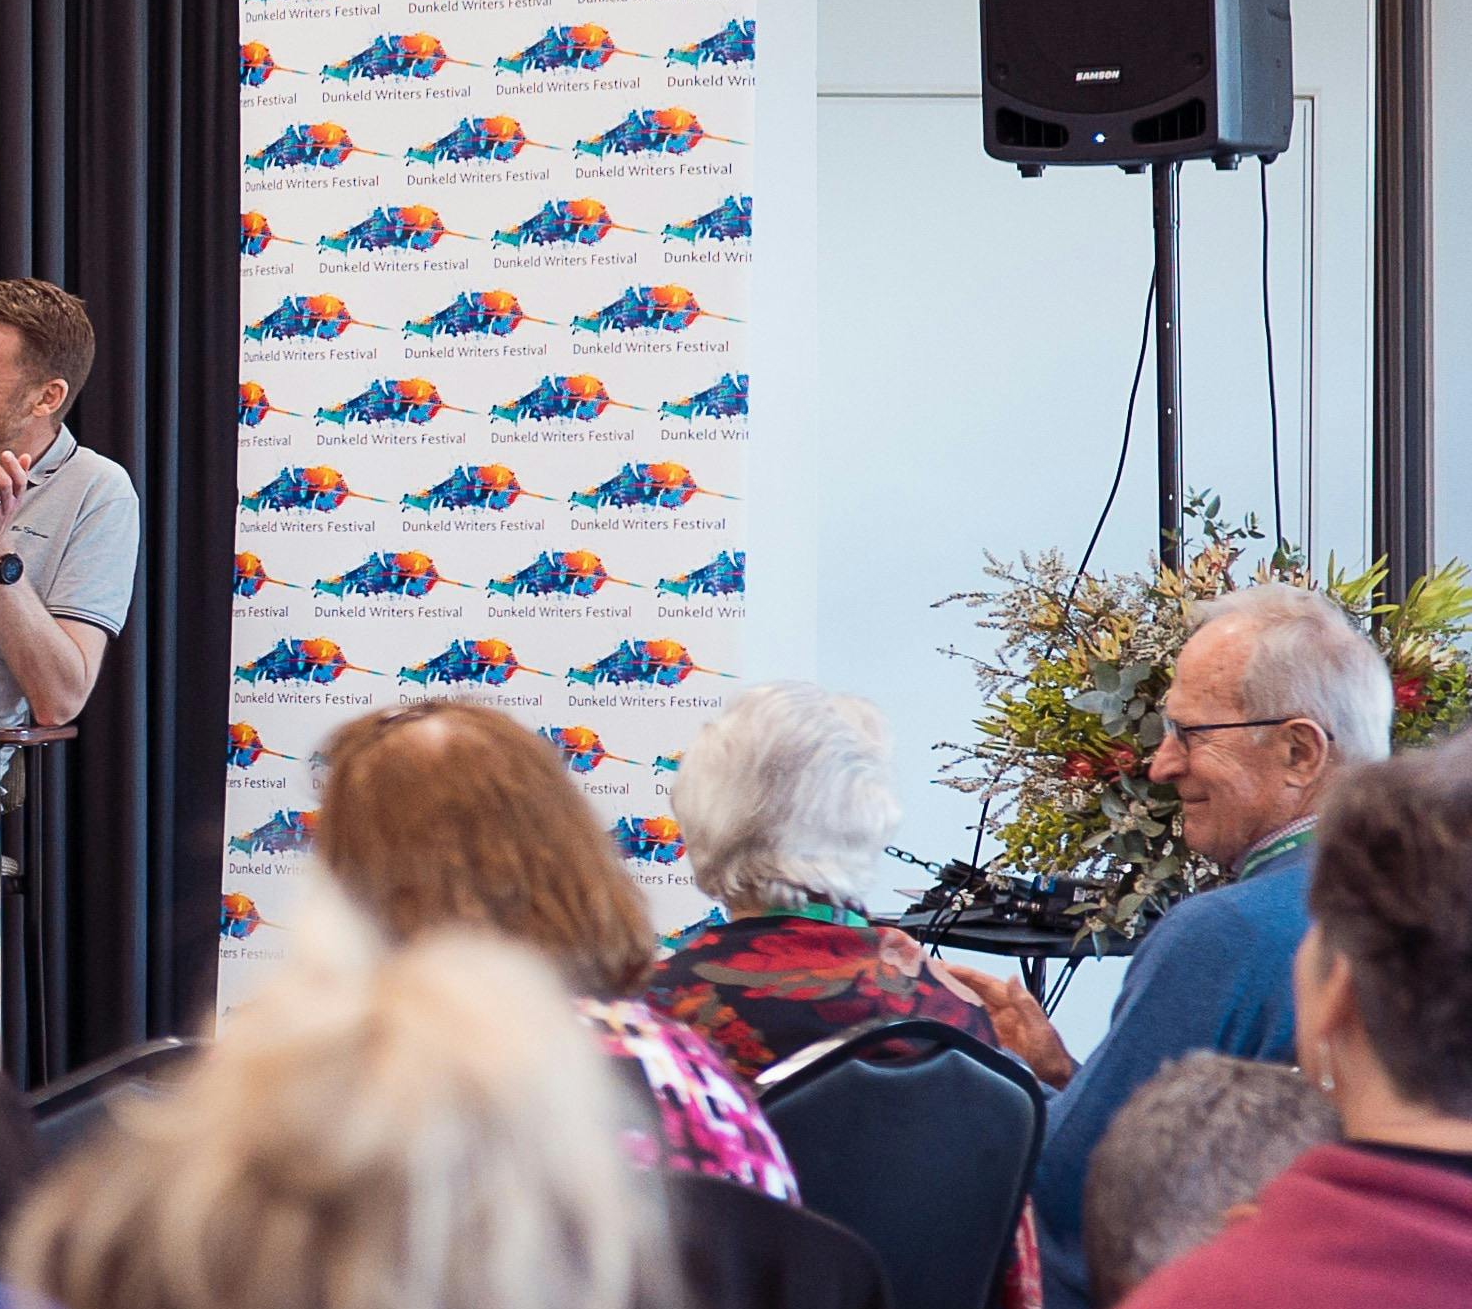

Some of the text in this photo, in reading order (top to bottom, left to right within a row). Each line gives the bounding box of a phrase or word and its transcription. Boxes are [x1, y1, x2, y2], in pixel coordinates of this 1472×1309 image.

[245, 3, 381, 23] Dunkeld Writers Festival
[408, 0, 459, 14] Dunkeld
[461, 0, 505, 11] Writers
[667, 74, 724, 87] Dunkeld
[1075, 69, 1121, 82] SAMSON
[496, 76, 640, 96] Dunkeld Writers Festival
[257, 93, 297, 107] Festival
[322, 85, 471, 104] Dunkeld Writers Festival
[407, 168, 550, 186] Dunkeld Writers Festival
[575, 162, 732, 180] Dunkeld Writers Festival
[244, 174, 379, 193] Dunkeld Writers Festival
[493, 252, 637, 269] Dunkeld Writers Festival
[664, 250, 720, 263] Dunkeld
[255, 263, 294, 276] Festival
[319, 258, 469, 274] Dunkeld Writers Festival
[404, 343, 547, 360] Dunkeld Writers Festival
[573, 340, 729, 355] Dunkeld Writers Festival
[243, 348, 377, 363] Dunkeld Writers Festival
[252, 435, 292, 448] Festival
[316, 432, 466, 446] Dunkeld Writers Festival
[491, 428, 634, 444] Dunkeld Writers Festival
[660, 428, 717, 441] Dunkeld
[239, 520, 376, 533] Dunkeld Writers Festival
[402, 519, 545, 532] Dunkeld Writers Festival
[570, 517, 726, 531] Dunkeld Writers Festival
[248, 605, 289, 618] Festival
[314, 605, 463, 618] Dunkeld Writers Festival
[488, 605, 632, 618] Dunkeld Writers Festival
[657, 605, 714, 618] Dunkeld
[234, 691, 373, 705] Dunkeld Writers Festival
[497, 694, 543, 707] Festival
[568, 694, 722, 708] Dunkeld Writers Festival
[244, 777, 286, 789] Festival
[583, 782, 630, 795] Festival
[229, 862, 272, 875] Dunkeld
